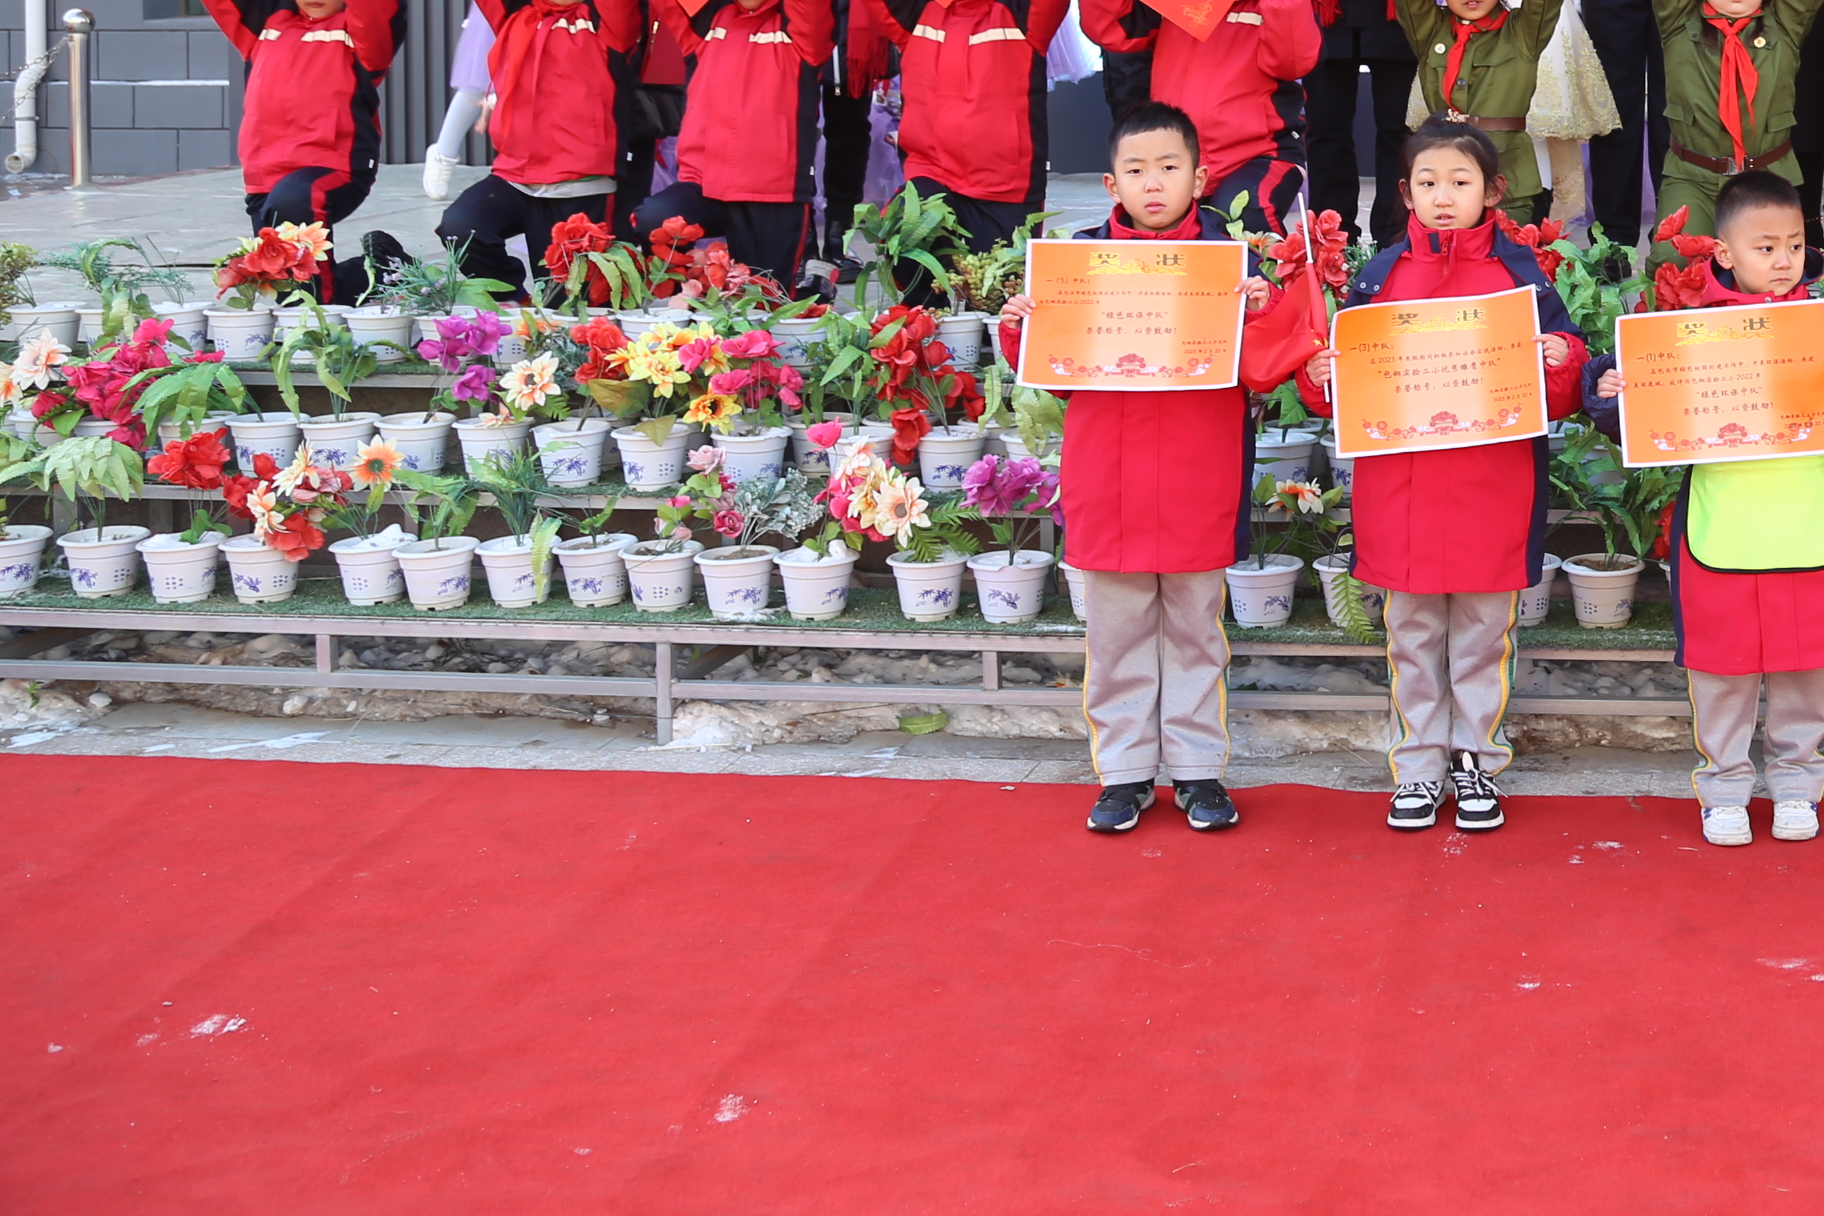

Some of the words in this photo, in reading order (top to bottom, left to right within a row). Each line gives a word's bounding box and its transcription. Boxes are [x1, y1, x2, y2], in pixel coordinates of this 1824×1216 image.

[1089, 252, 1187, 267] 奖状
[1391, 307, 1486, 326] 奖状
[1676, 317, 1772, 336] 奖状
